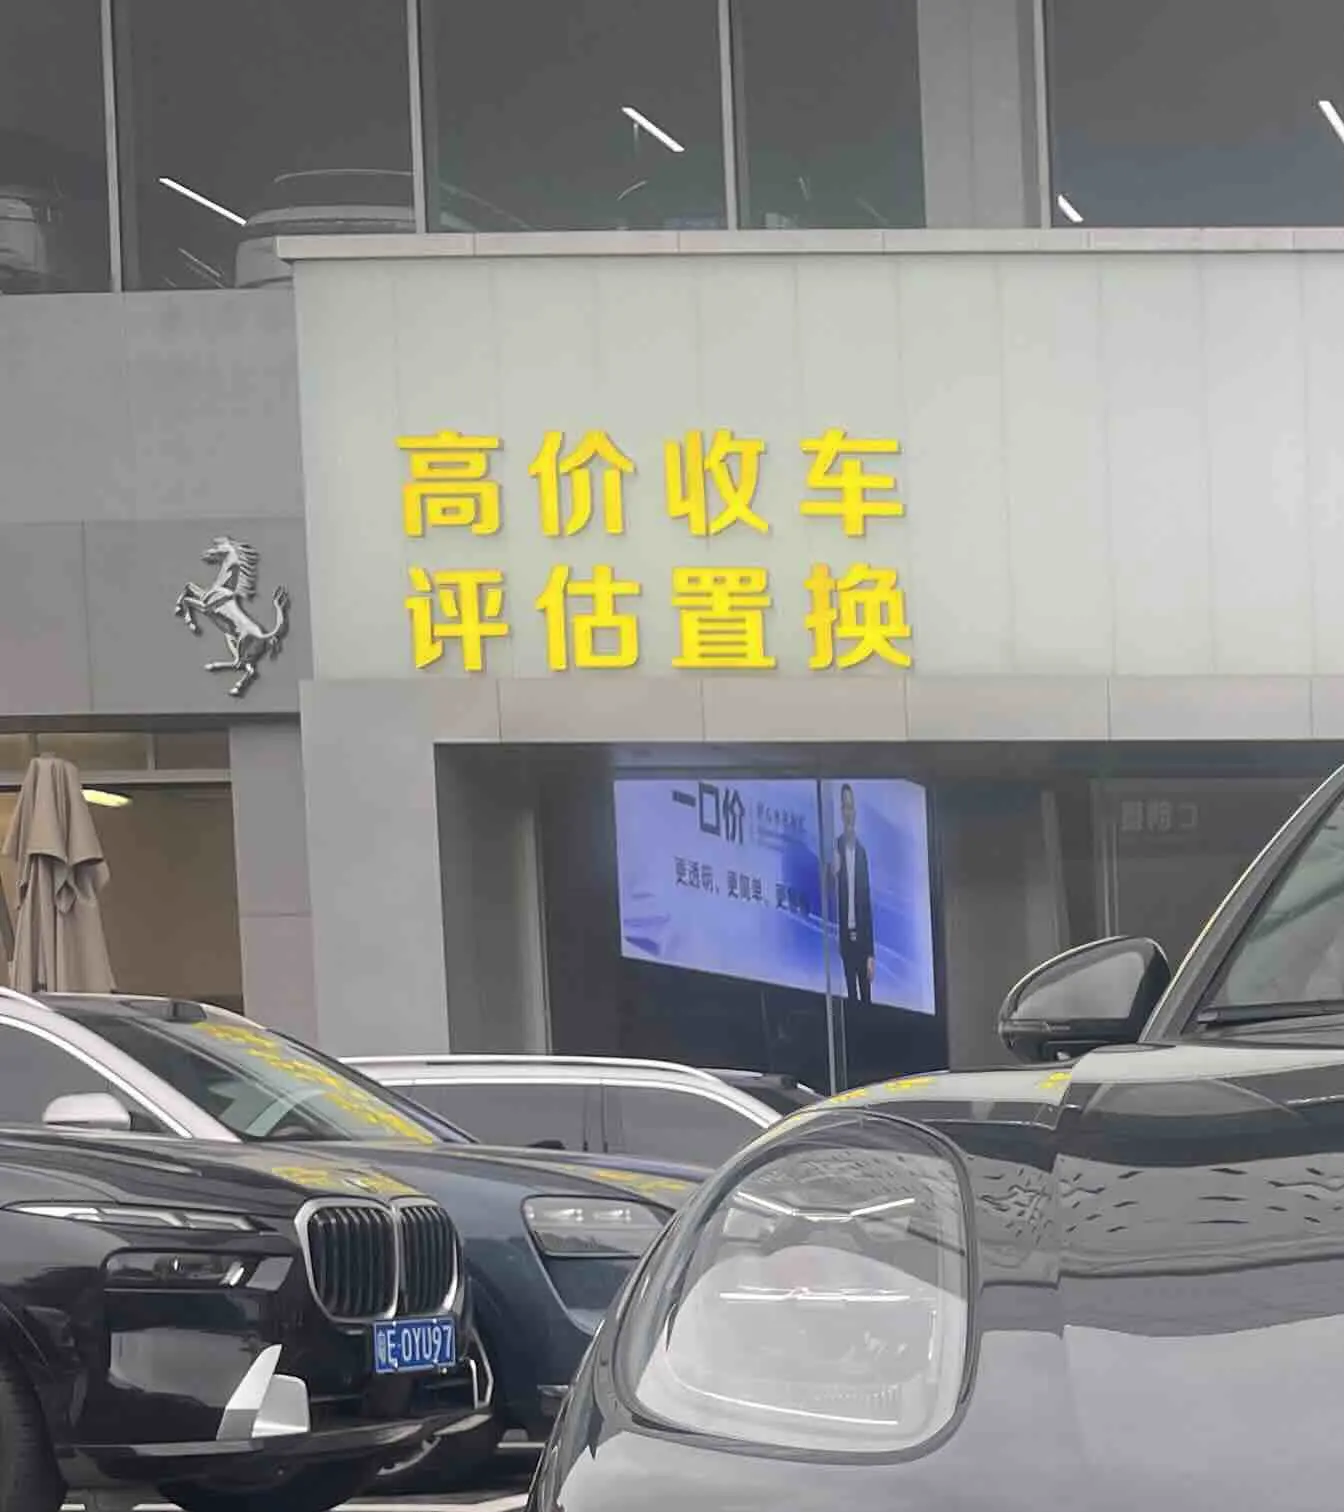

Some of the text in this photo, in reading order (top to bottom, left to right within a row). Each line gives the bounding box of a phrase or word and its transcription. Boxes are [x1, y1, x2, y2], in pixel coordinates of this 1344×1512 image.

[395, 428, 906, 538] 高价收车
[404, 562, 914, 673] 评估置换
[672, 782, 745, 844] 一口价
